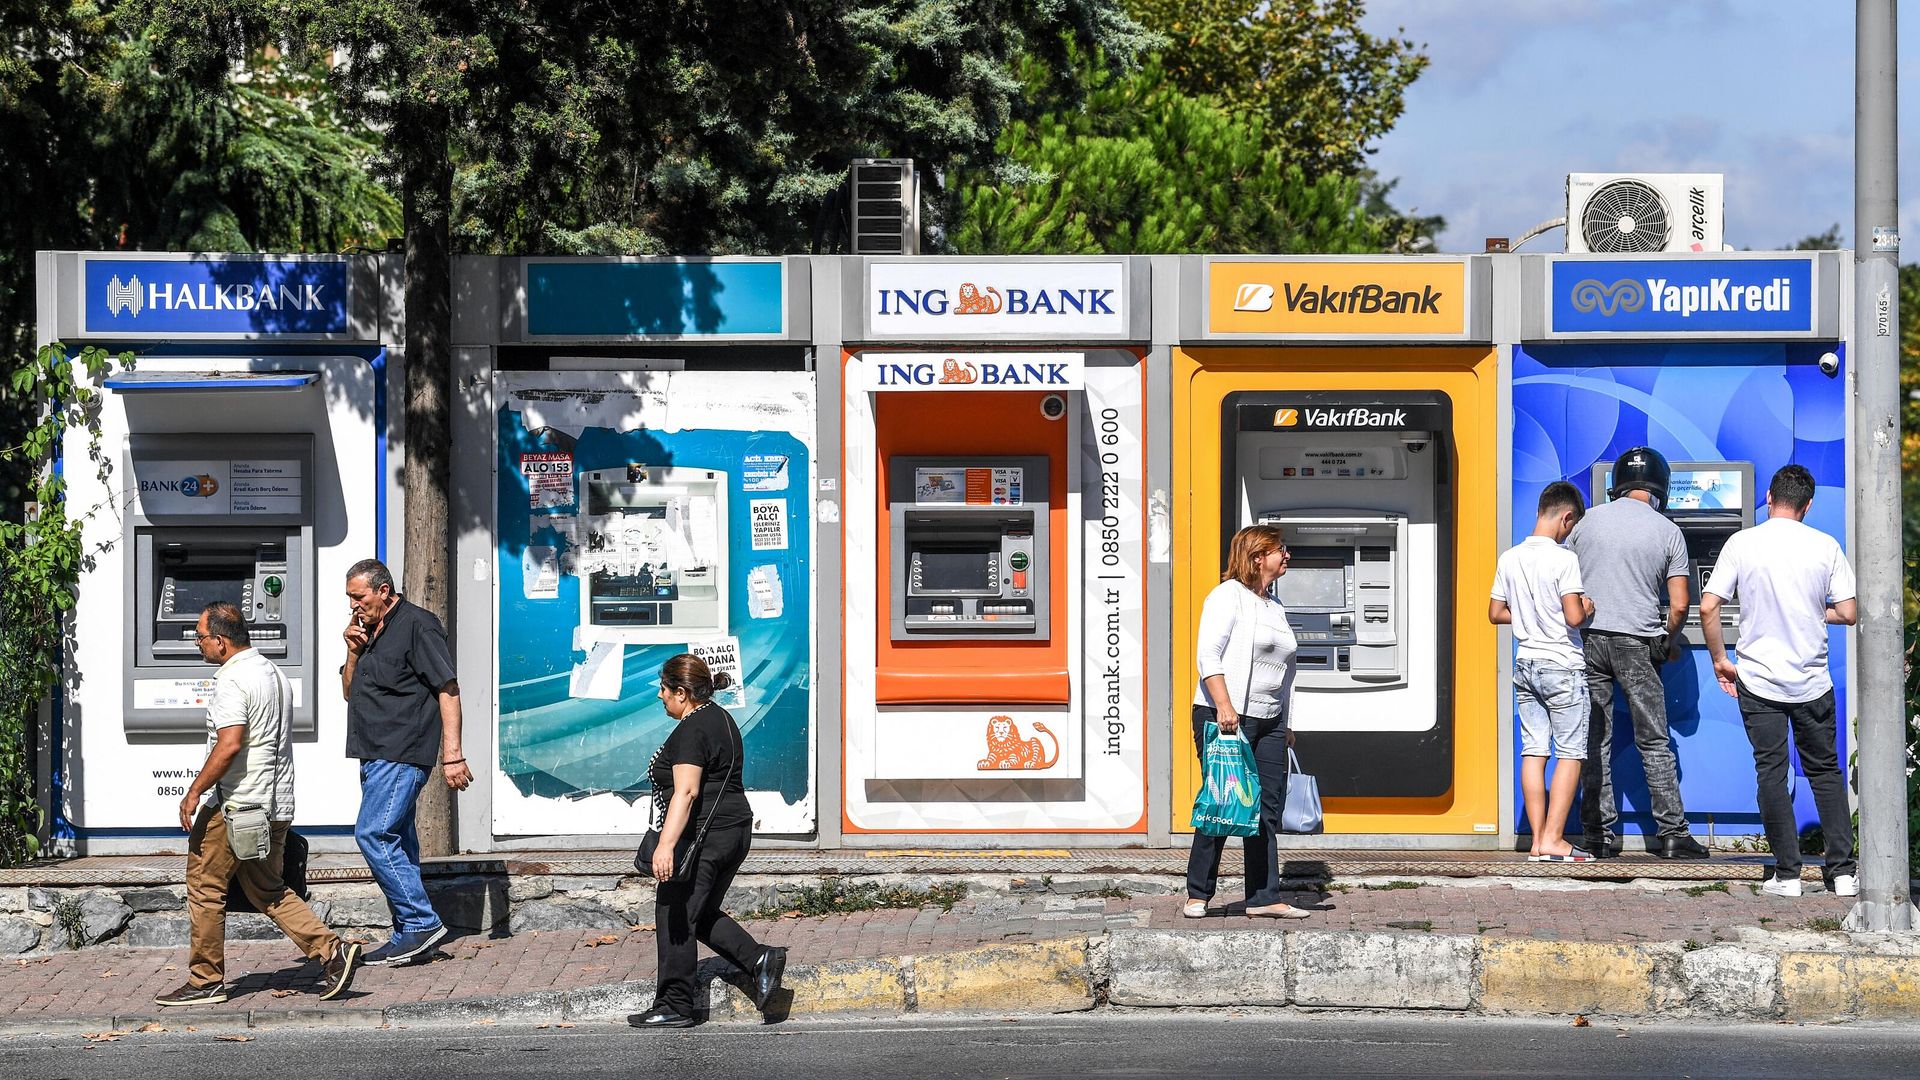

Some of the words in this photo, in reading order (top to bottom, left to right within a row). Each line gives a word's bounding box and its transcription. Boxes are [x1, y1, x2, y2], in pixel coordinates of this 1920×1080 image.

[1690, 186, 1708, 241] arçelik
[149, 283, 325, 311] HALKBANK
[878, 289, 949, 315] ING
[1006, 289, 1115, 315] BANK
[1284, 283, 1443, 314] VakıfBank
[1646, 277, 1791, 317] YapıKredi
[878, 363, 936, 385] ING
[981, 363, 1070, 385] BANK
[1101, 407, 1119, 446] 600
[1304, 408, 1407, 427] VakıfBank
[524, 463, 549, 473] ALO
[551, 462, 570, 472] 153
[1101, 452, 1118, 464] 0
[141, 480, 180, 492] BANK
[183, 481, 198, 492] 24
[1101, 471, 1119, 509] 222
[753, 505, 780, 514] BOYA
[756, 513, 778, 521] ALÇI
[1101, 515, 1119, 567] 0850
[702, 654, 735, 666] ADANA
[716, 644, 735, 654] ALÇI
[1103, 588, 1124, 756] ingbank.com.tr
[157, 786, 184, 796] 0850
